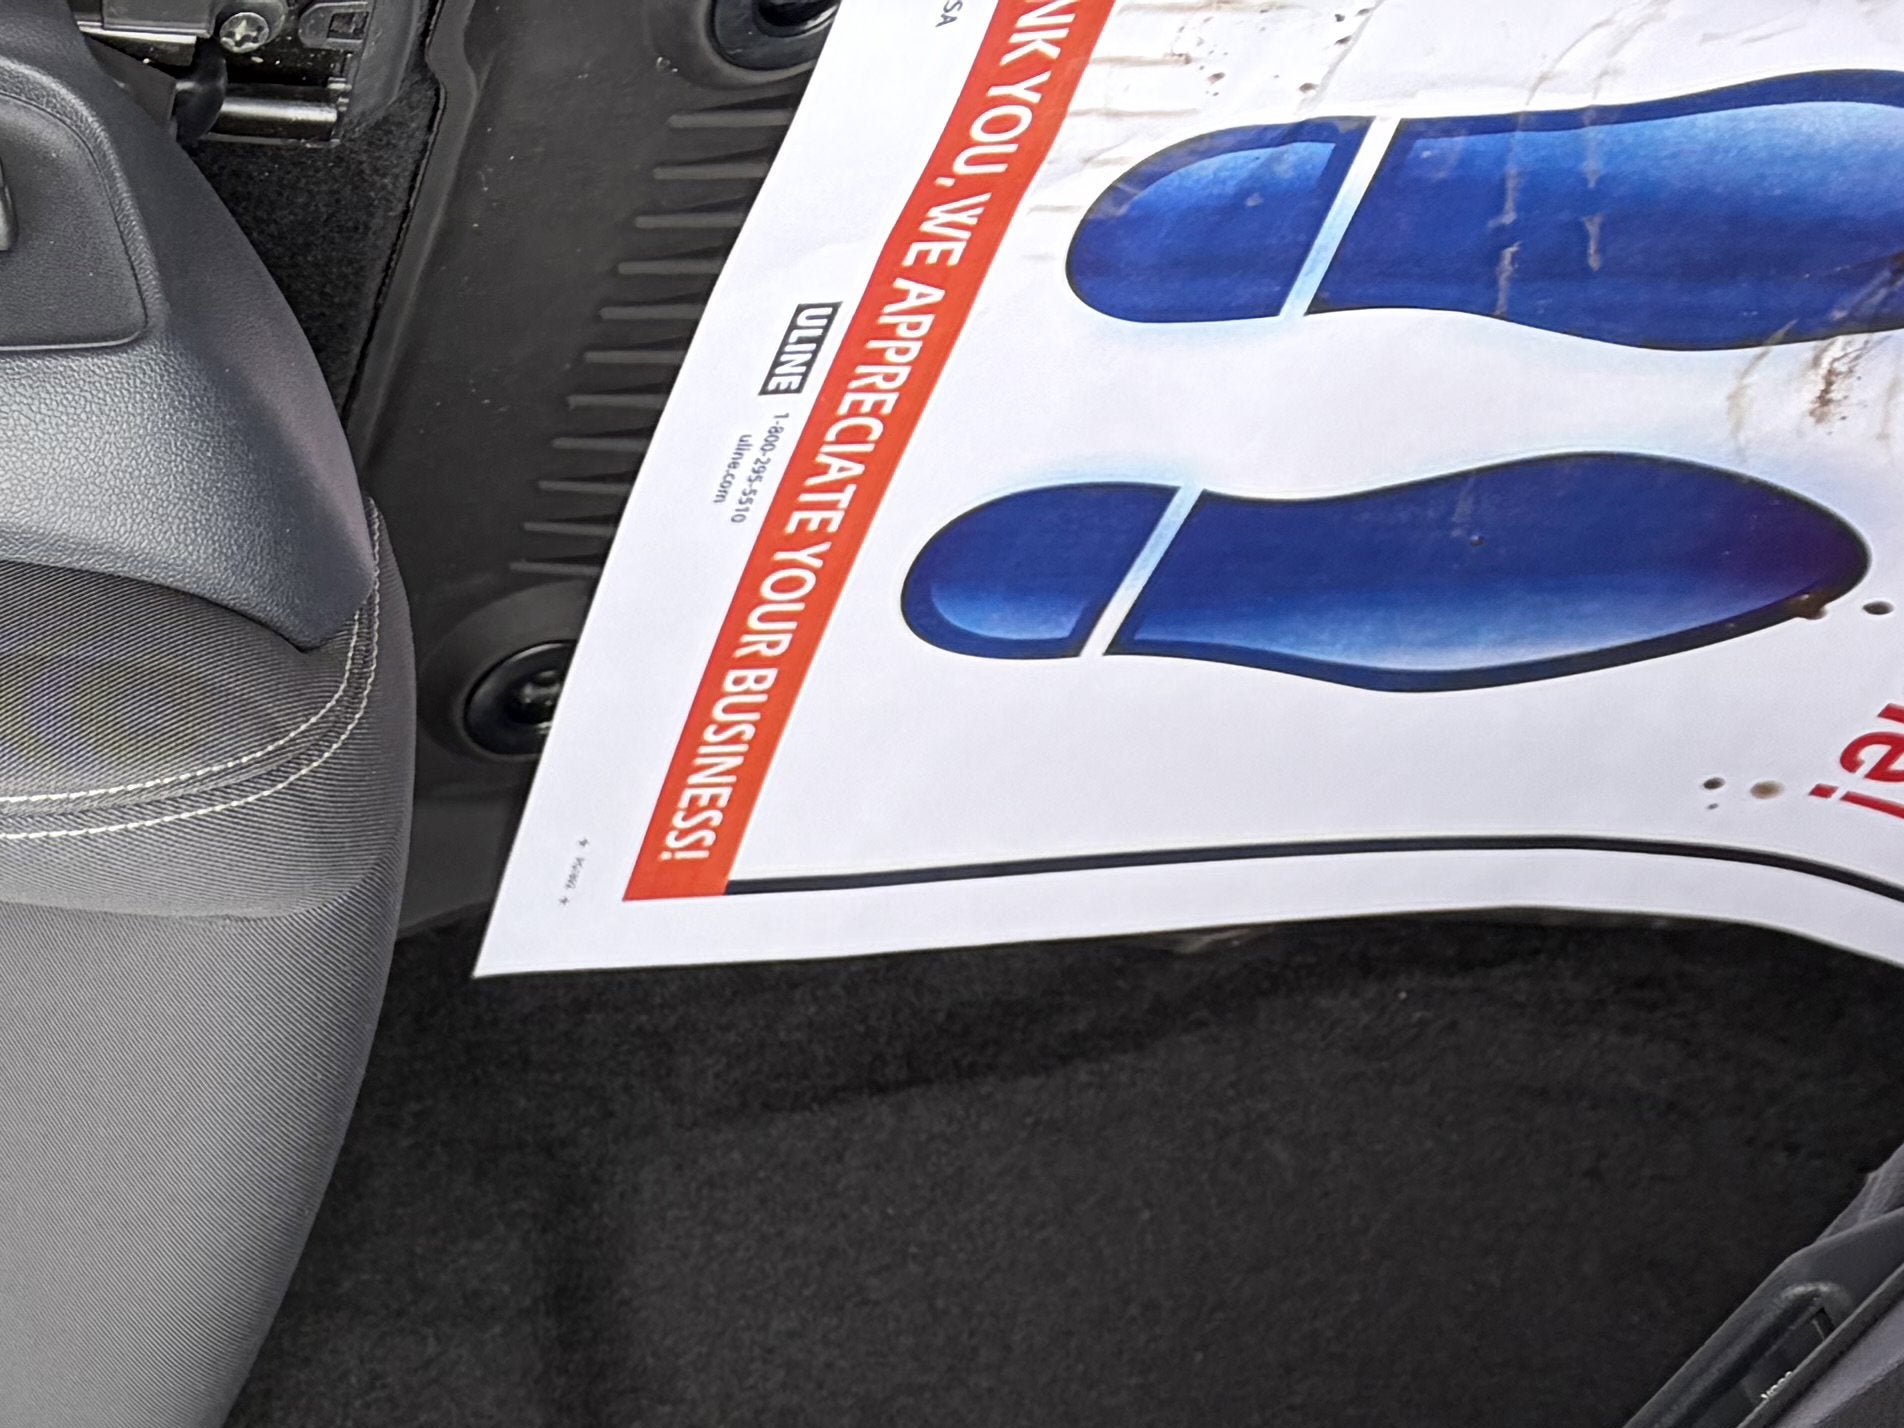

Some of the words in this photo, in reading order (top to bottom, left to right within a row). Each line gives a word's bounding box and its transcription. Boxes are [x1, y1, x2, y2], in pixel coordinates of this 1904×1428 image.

[934, 70, 1052, 188] YOU,
[901, 192, 992, 268] WE
[766, 306, 834, 392] ULINE
[784, 277, 946, 534] APPRECIATE
[713, 434, 753, 504] uline.com
[730, 412, 790, 524] 1-800-295-5510
[732, 541, 833, 659] YOUR
[658, 667, 779, 862] BUSINESS!
